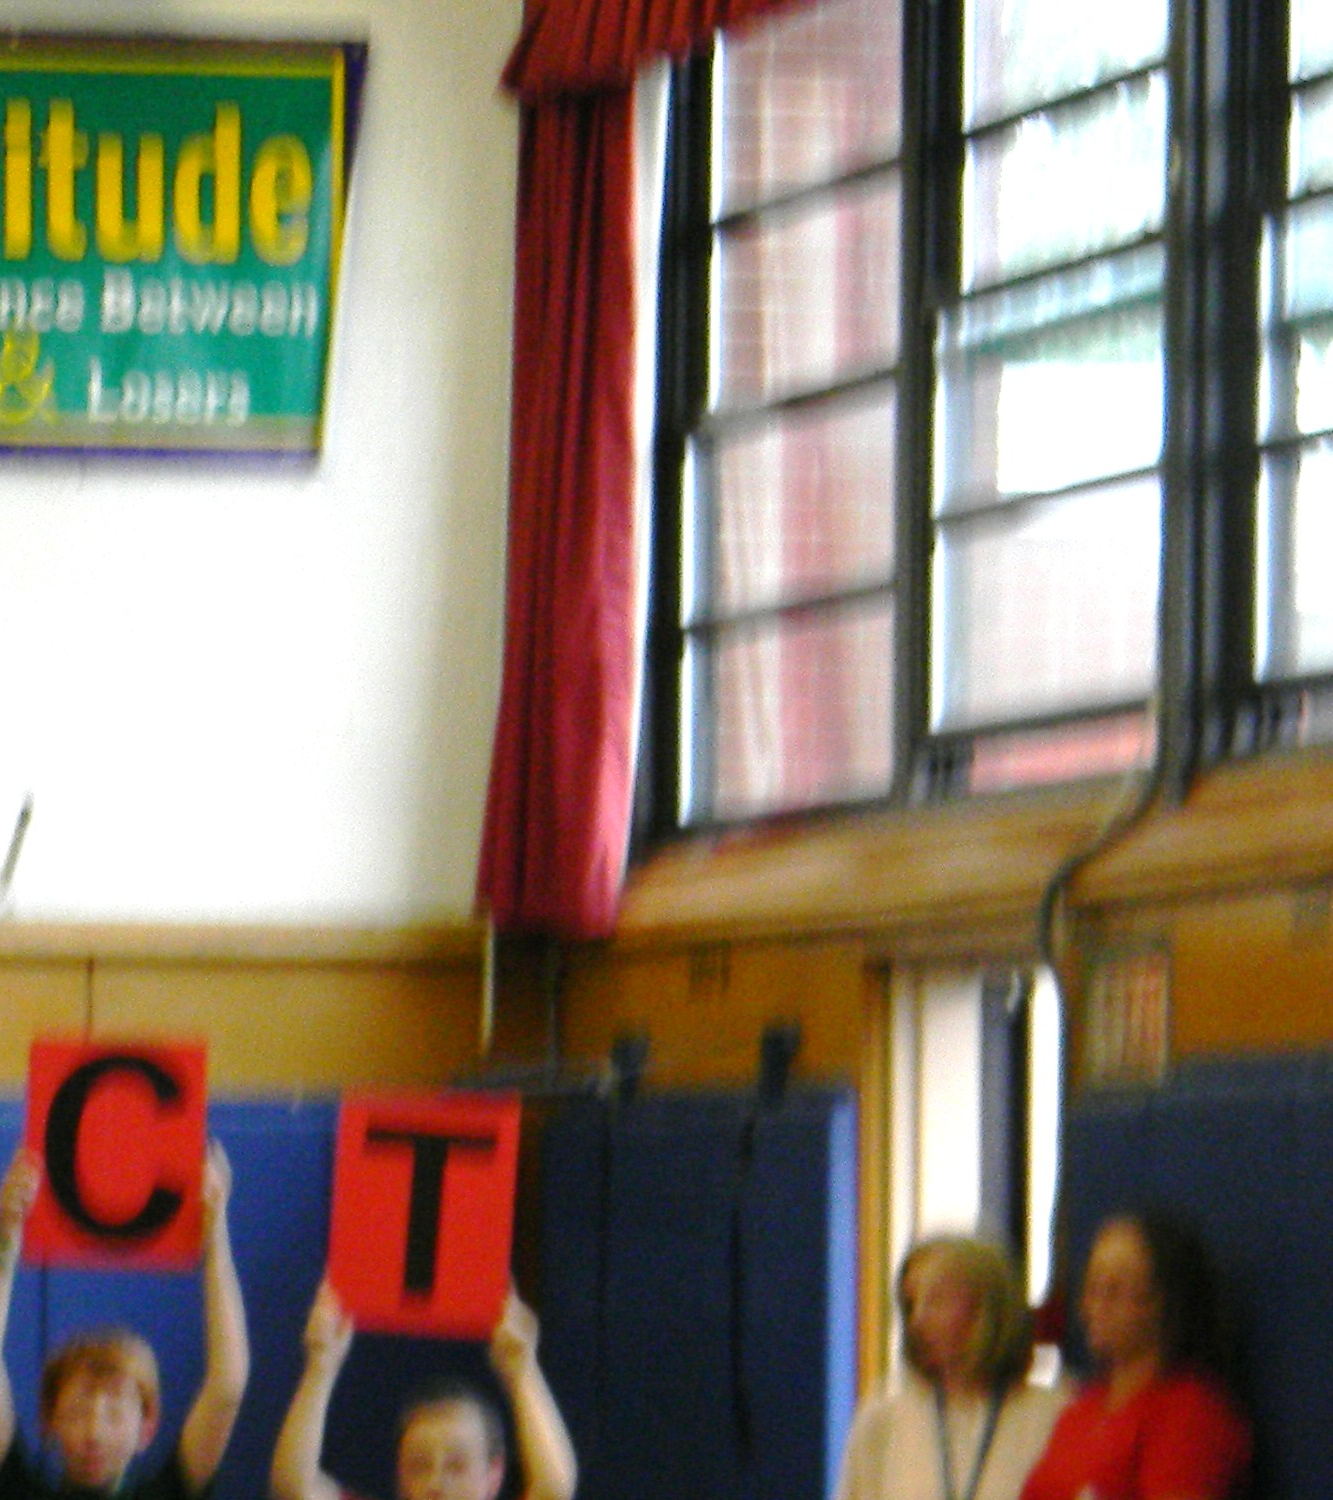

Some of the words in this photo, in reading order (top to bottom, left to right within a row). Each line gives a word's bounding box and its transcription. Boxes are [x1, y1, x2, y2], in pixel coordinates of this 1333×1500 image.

[100, 266, 318, 339] Between
[88, 358, 250, 429] Losers
[44, 1052, 183, 1239] C
[363, 1122, 498, 1302] T
